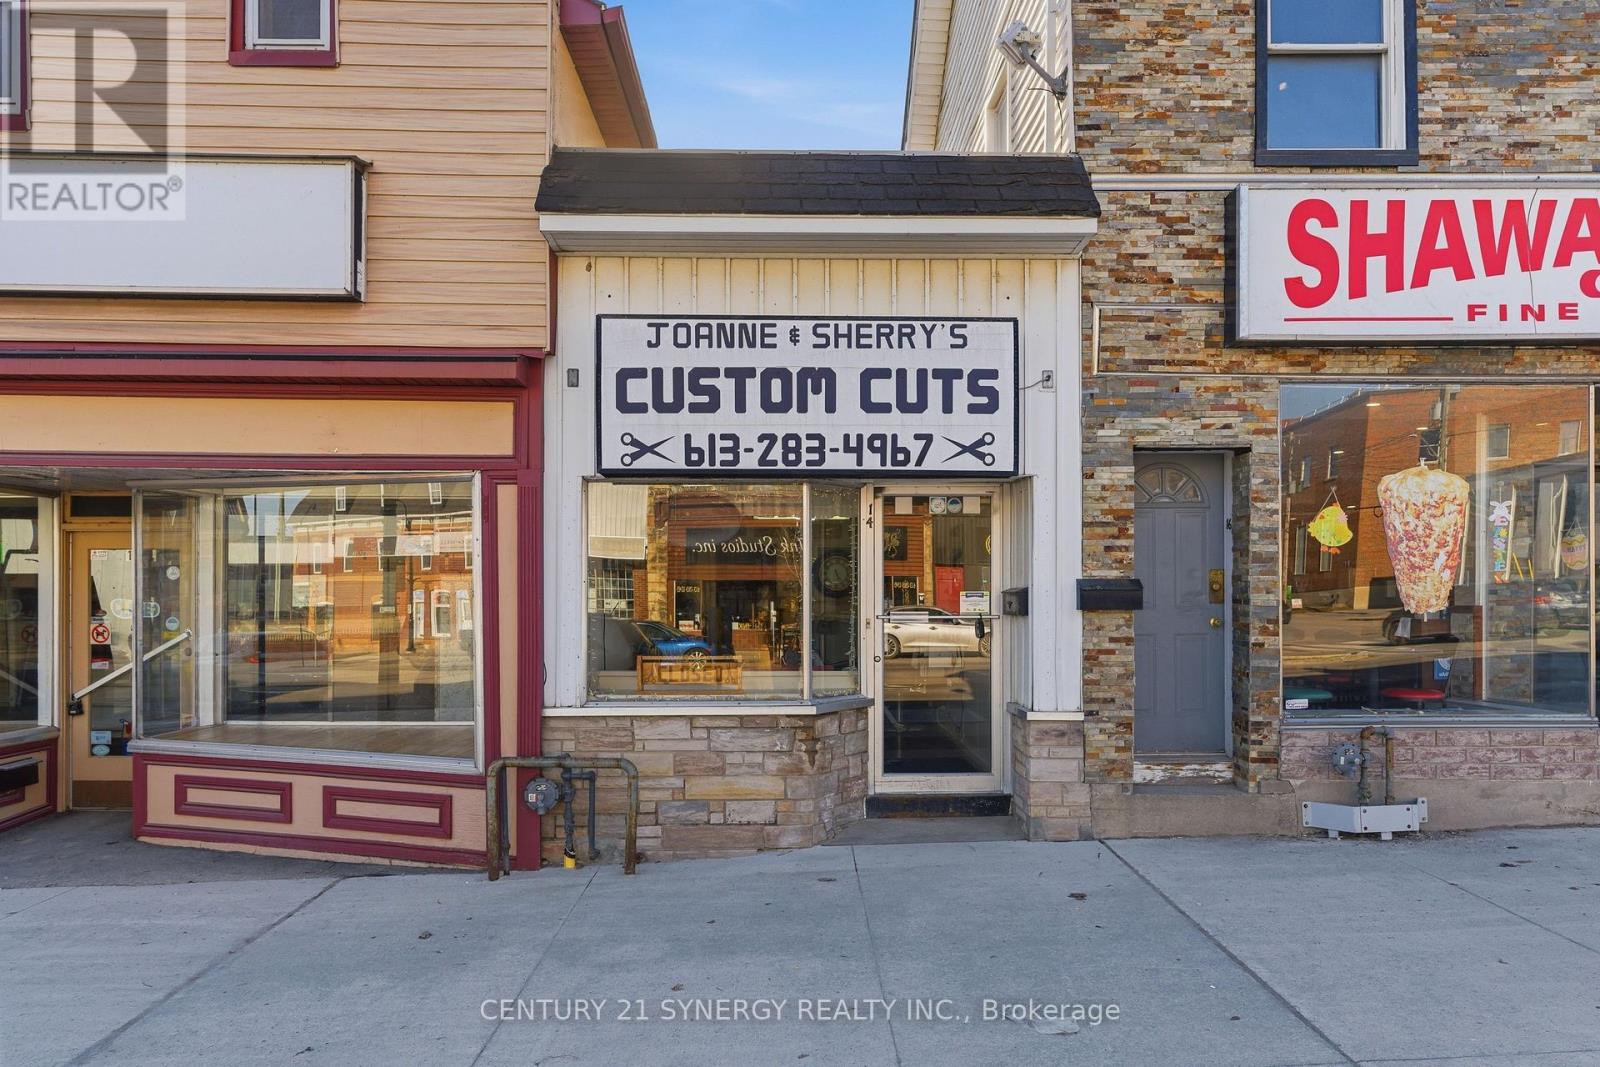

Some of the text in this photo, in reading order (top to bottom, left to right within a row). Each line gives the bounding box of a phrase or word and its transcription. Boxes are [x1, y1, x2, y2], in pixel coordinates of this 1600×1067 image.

[1284, 197, 1600, 309] SHAWA
[1467, 302, 1579, 322] FINE
[647, 322, 777, 349] JOANNE
[812, 322, 968, 349] SHERRY'S
[615, 366, 1000, 415] CUSTOM CUTS
[683, 432, 934, 467] 613-283-4967
